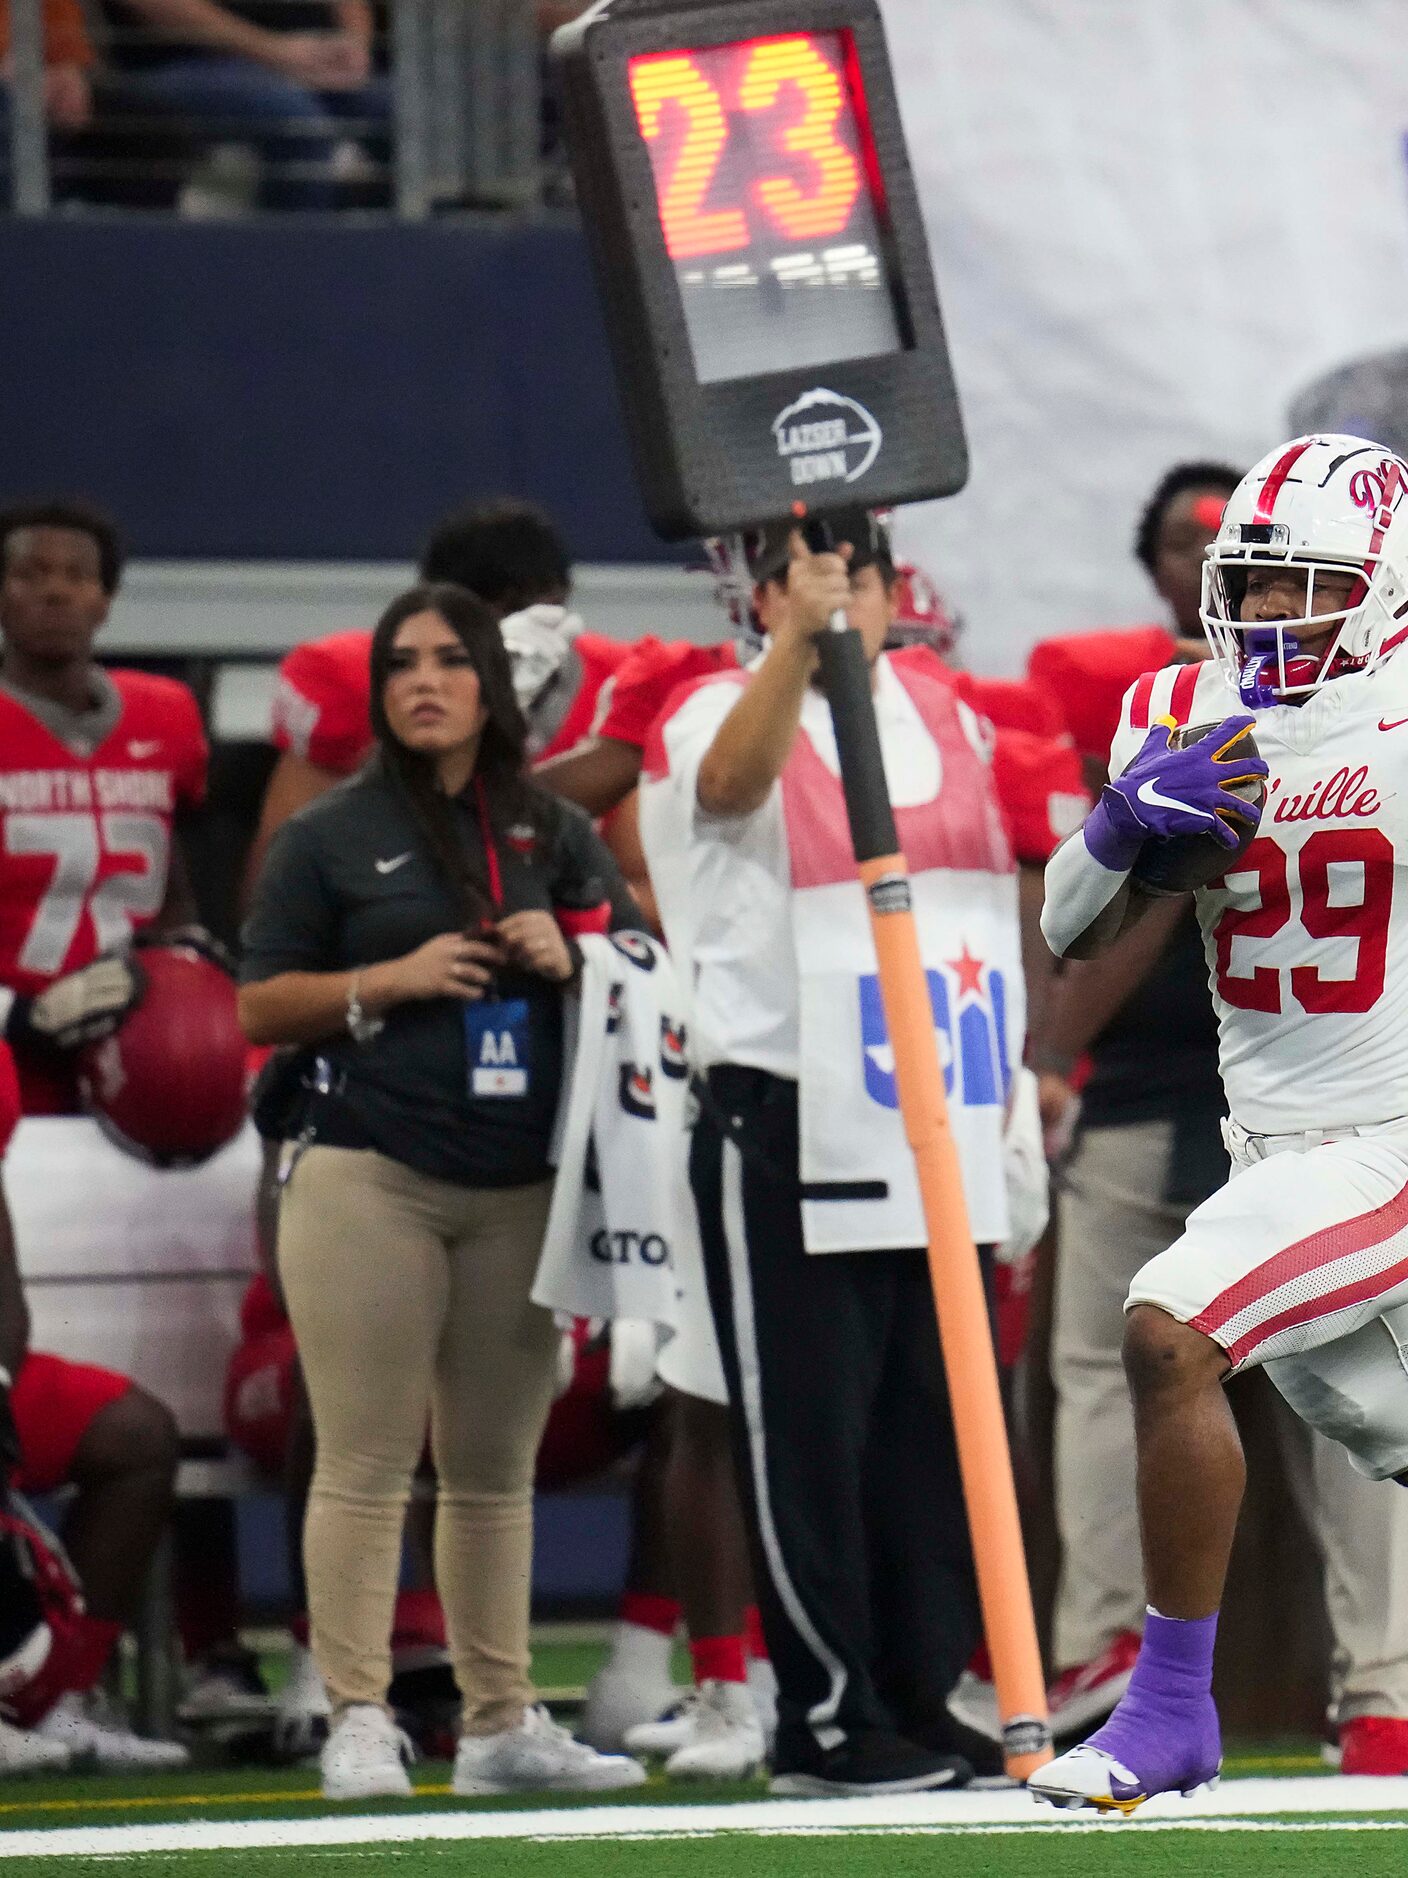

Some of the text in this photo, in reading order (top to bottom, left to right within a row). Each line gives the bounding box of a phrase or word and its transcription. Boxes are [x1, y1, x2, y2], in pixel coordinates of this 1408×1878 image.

[632, 40, 859, 260] 23
[1263, 765, 1381, 824] 'ville
[6, 813, 169, 974] 72
[1205, 827, 1394, 1015] 29
[480, 1030, 518, 1066] AA
